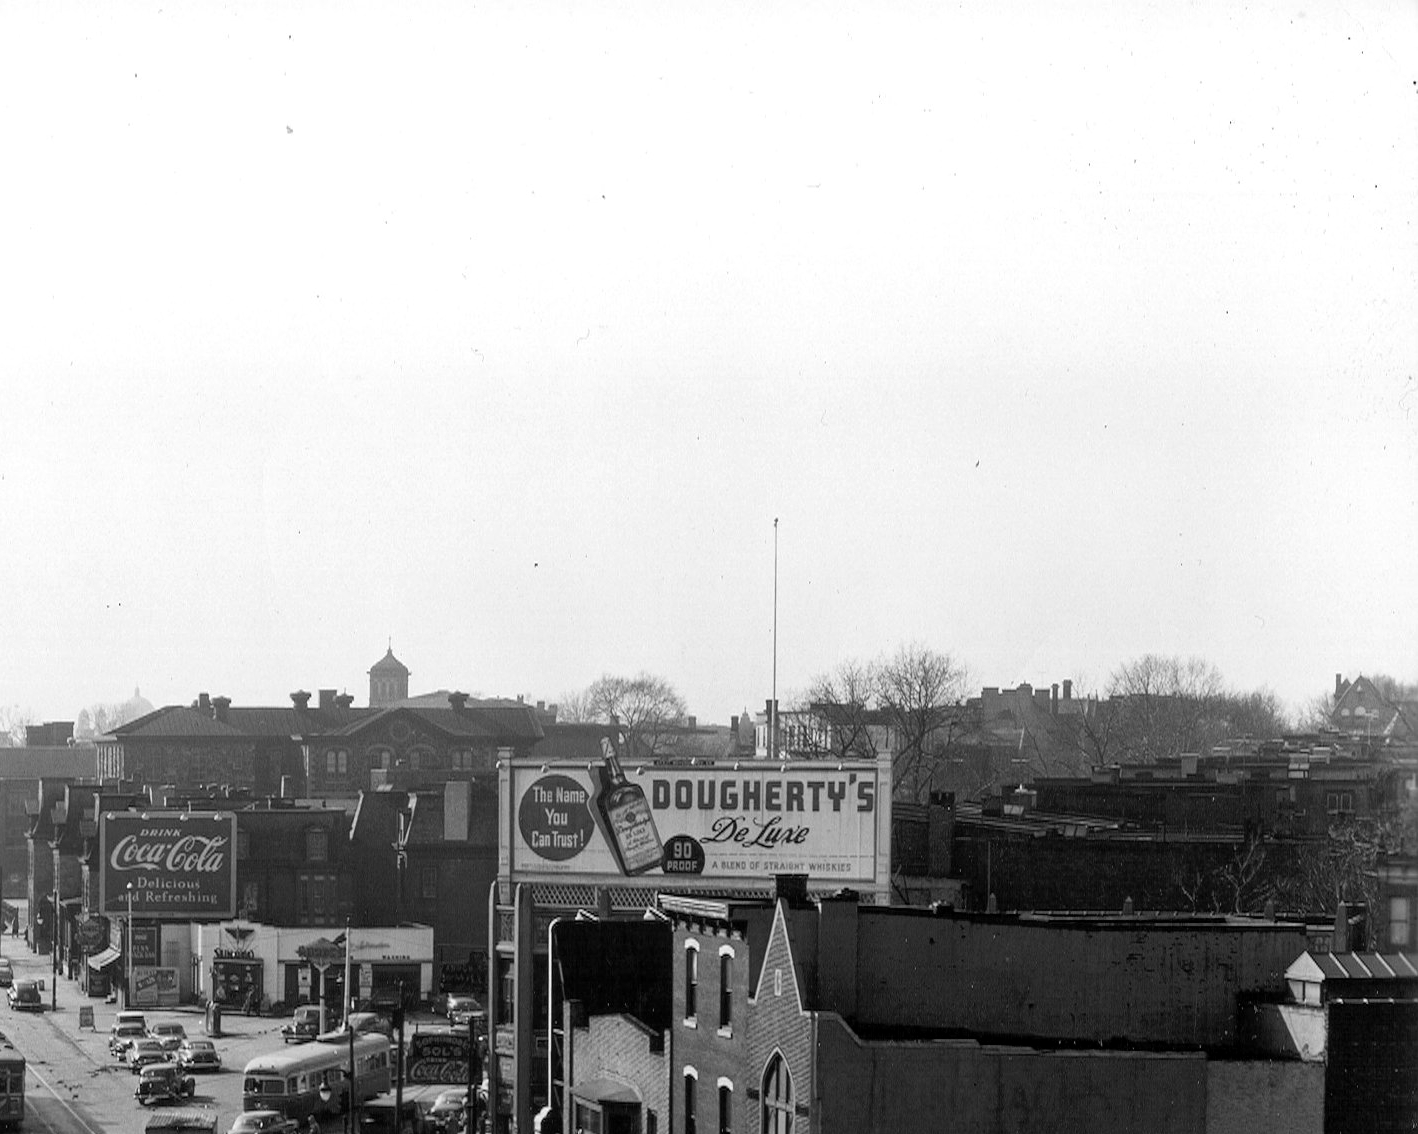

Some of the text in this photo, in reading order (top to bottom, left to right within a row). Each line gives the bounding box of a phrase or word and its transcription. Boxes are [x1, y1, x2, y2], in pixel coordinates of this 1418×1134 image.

[532, 786, 585, 803] The Name
[652, 774, 874, 812] DOUGHERTY'S
[545, 808, 568, 825] You
[532, 830, 550, 848] Can
[699, 816, 810, 849] De Luxe
[110, 834, 229, 872] Coca-Cola
[673, 841, 692, 859] 90
[666, 861, 698, 871] PROOF
[712, 861, 852, 872] A BLEND OF STRAIGHT WHISKIES
[137, 877, 200, 889] Delicious
[145, 891, 218, 905] Refreshing
